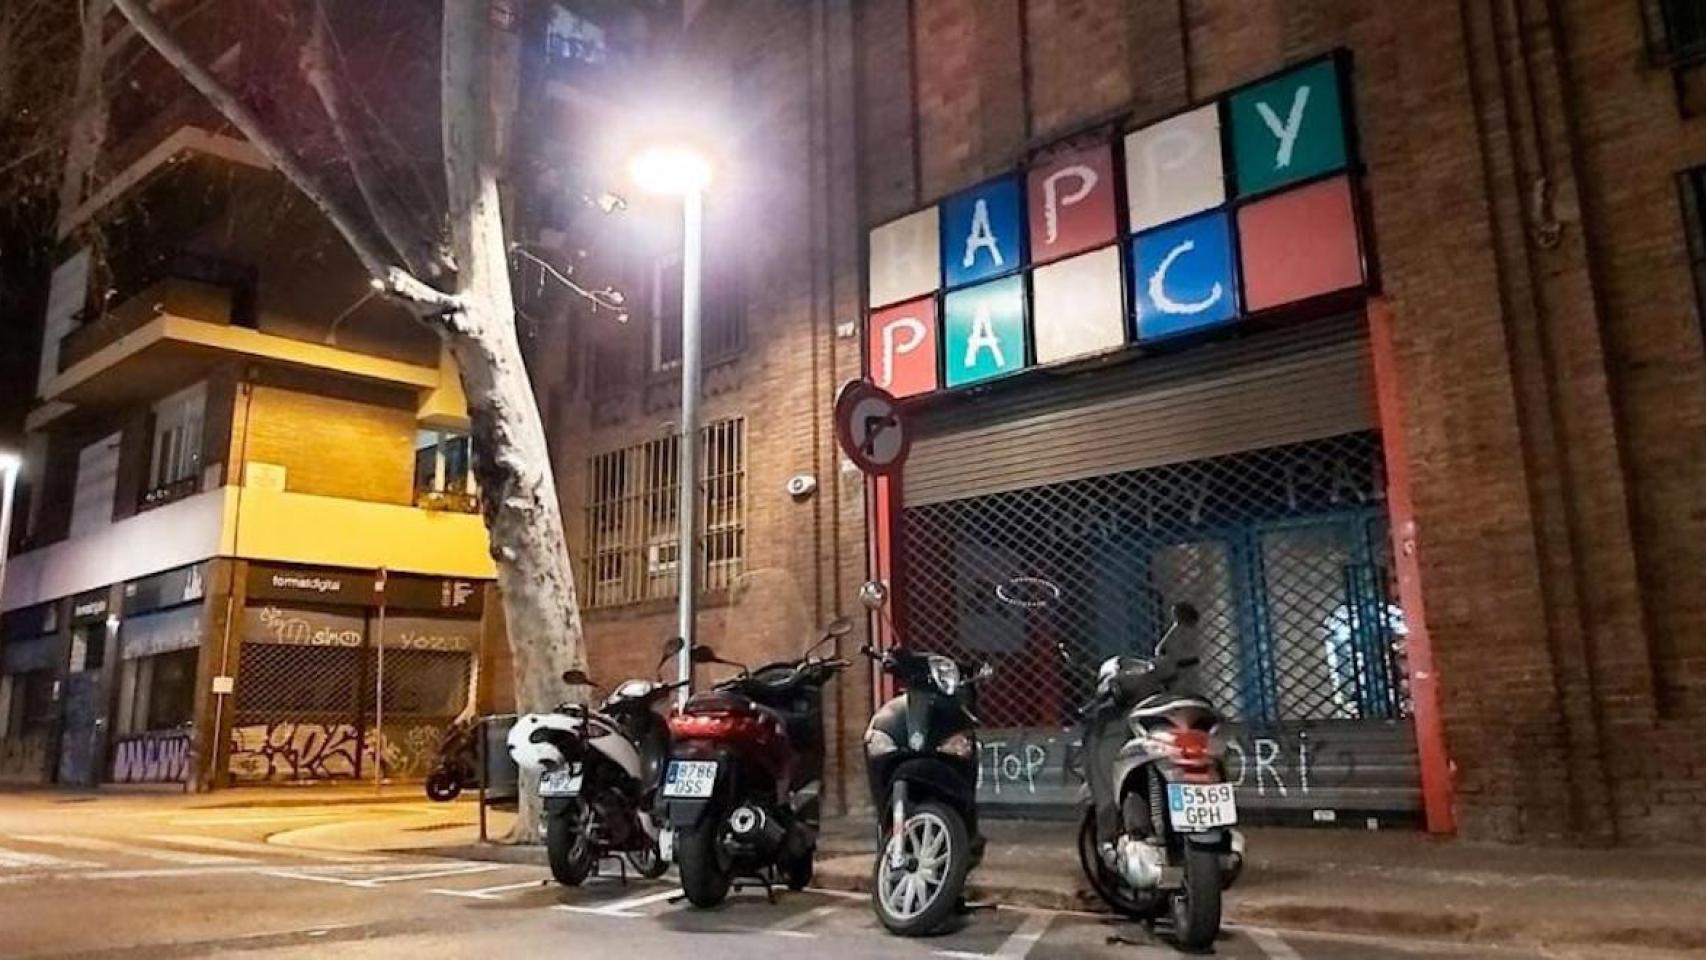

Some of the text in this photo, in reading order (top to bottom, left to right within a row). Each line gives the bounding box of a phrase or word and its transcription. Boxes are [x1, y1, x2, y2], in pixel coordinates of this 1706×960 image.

[881, 240, 1222, 388] PAC
[1183, 786, 1230, 804] 5569
[1186, 806, 1222, 824] GPH
